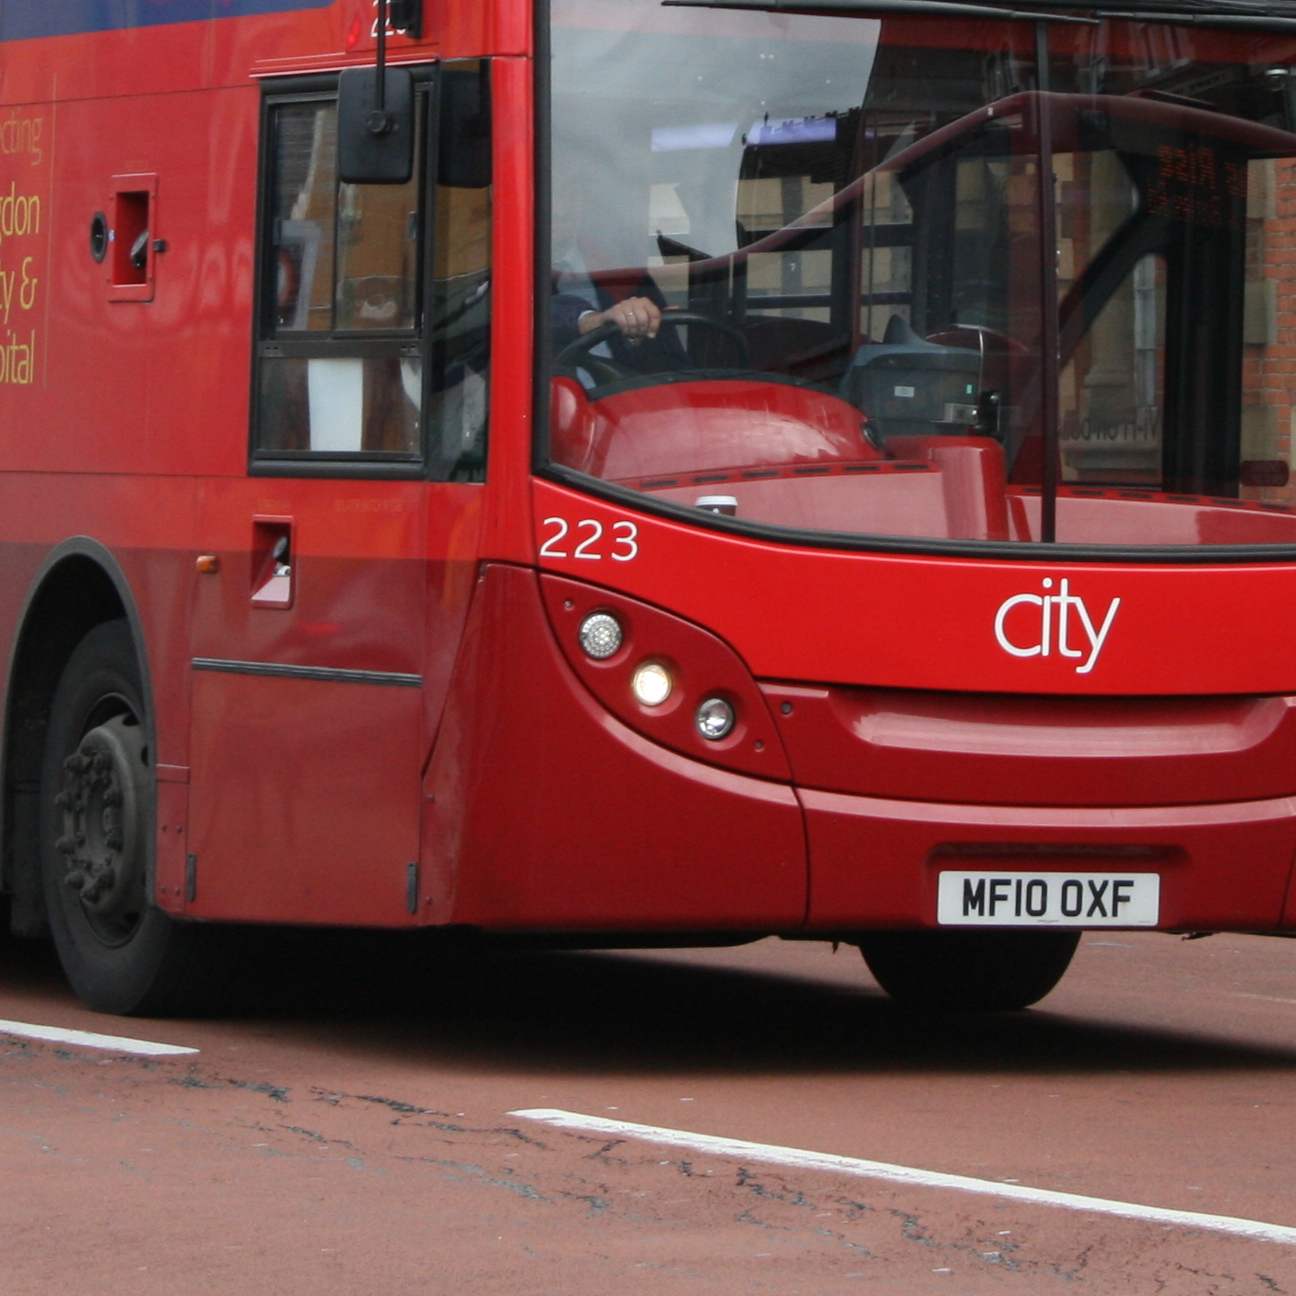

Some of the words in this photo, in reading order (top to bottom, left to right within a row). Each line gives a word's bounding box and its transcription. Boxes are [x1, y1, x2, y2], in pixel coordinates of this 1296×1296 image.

[19, 256, 39, 311] &
[539, 518, 640, 564] 223
[993, 576, 1122, 675] city
[962, 878, 1050, 919] MF10
[1060, 879, 1136, 920] OXF
